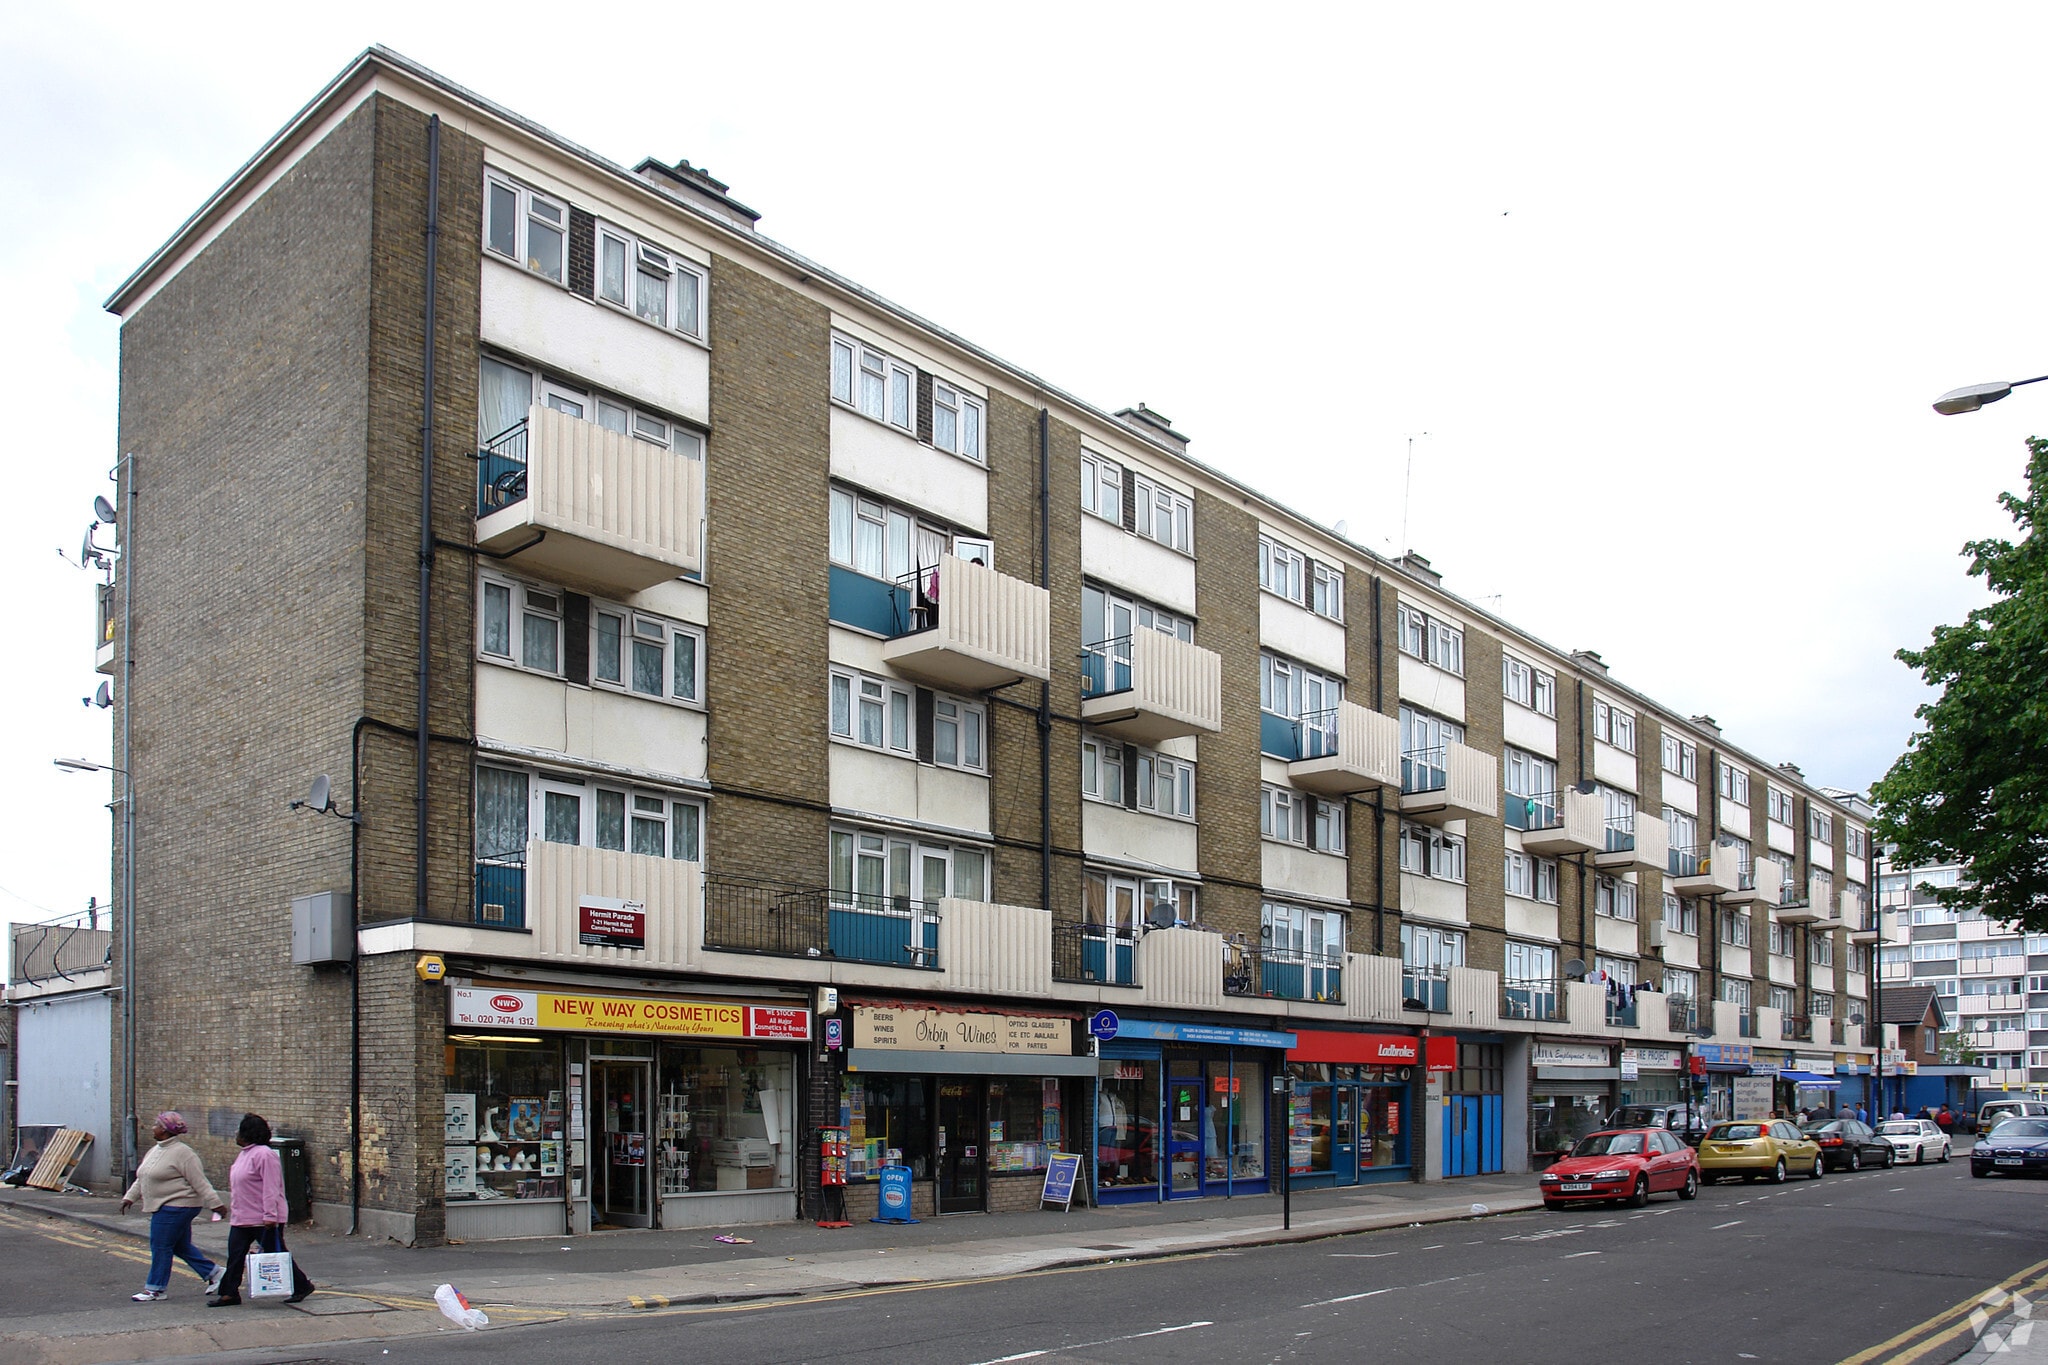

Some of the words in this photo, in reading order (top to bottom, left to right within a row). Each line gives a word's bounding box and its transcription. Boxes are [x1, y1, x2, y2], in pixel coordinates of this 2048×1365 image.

[590, 910, 611, 918] Hermit
[612, 912, 635, 920] Parade
[457, 990, 472, 998] No.1
[554, 999, 594, 1015] NEW
[602, 1002, 636, 1017] WAY
[643, 1004, 740, 1023] COSMETICS
[459, 1014, 474, 1022] Tel.
[477, 1015, 493, 1023] 020
[497, 1016, 514, 1024] 7474
[519, 1017, 534, 1026] 1312
[874, 1013, 893, 1021] BEERS
[585, 1017, 625, 1030] Renewing
[626, 1020, 650, 1030] what's
[650, 1021, 690, 1034] Naturally
[691, 1023, 714, 1033] Yours
[755, 1023, 782, 1031] Cosmetics
[874, 1025, 894, 1033] WINES
[916, 1020, 948, 1042] Orbin
[956, 1022, 997, 1044] Wines
[874, 1036, 897, 1044] SPIRITS
[1378, 1043, 1415, 1057] Ladbrokes
[1554, 1049, 1584, 1060] Employment
[1648, 1050, 1669, 1062] PROJECT
[1116, 1067, 1142, 1077] SALE
